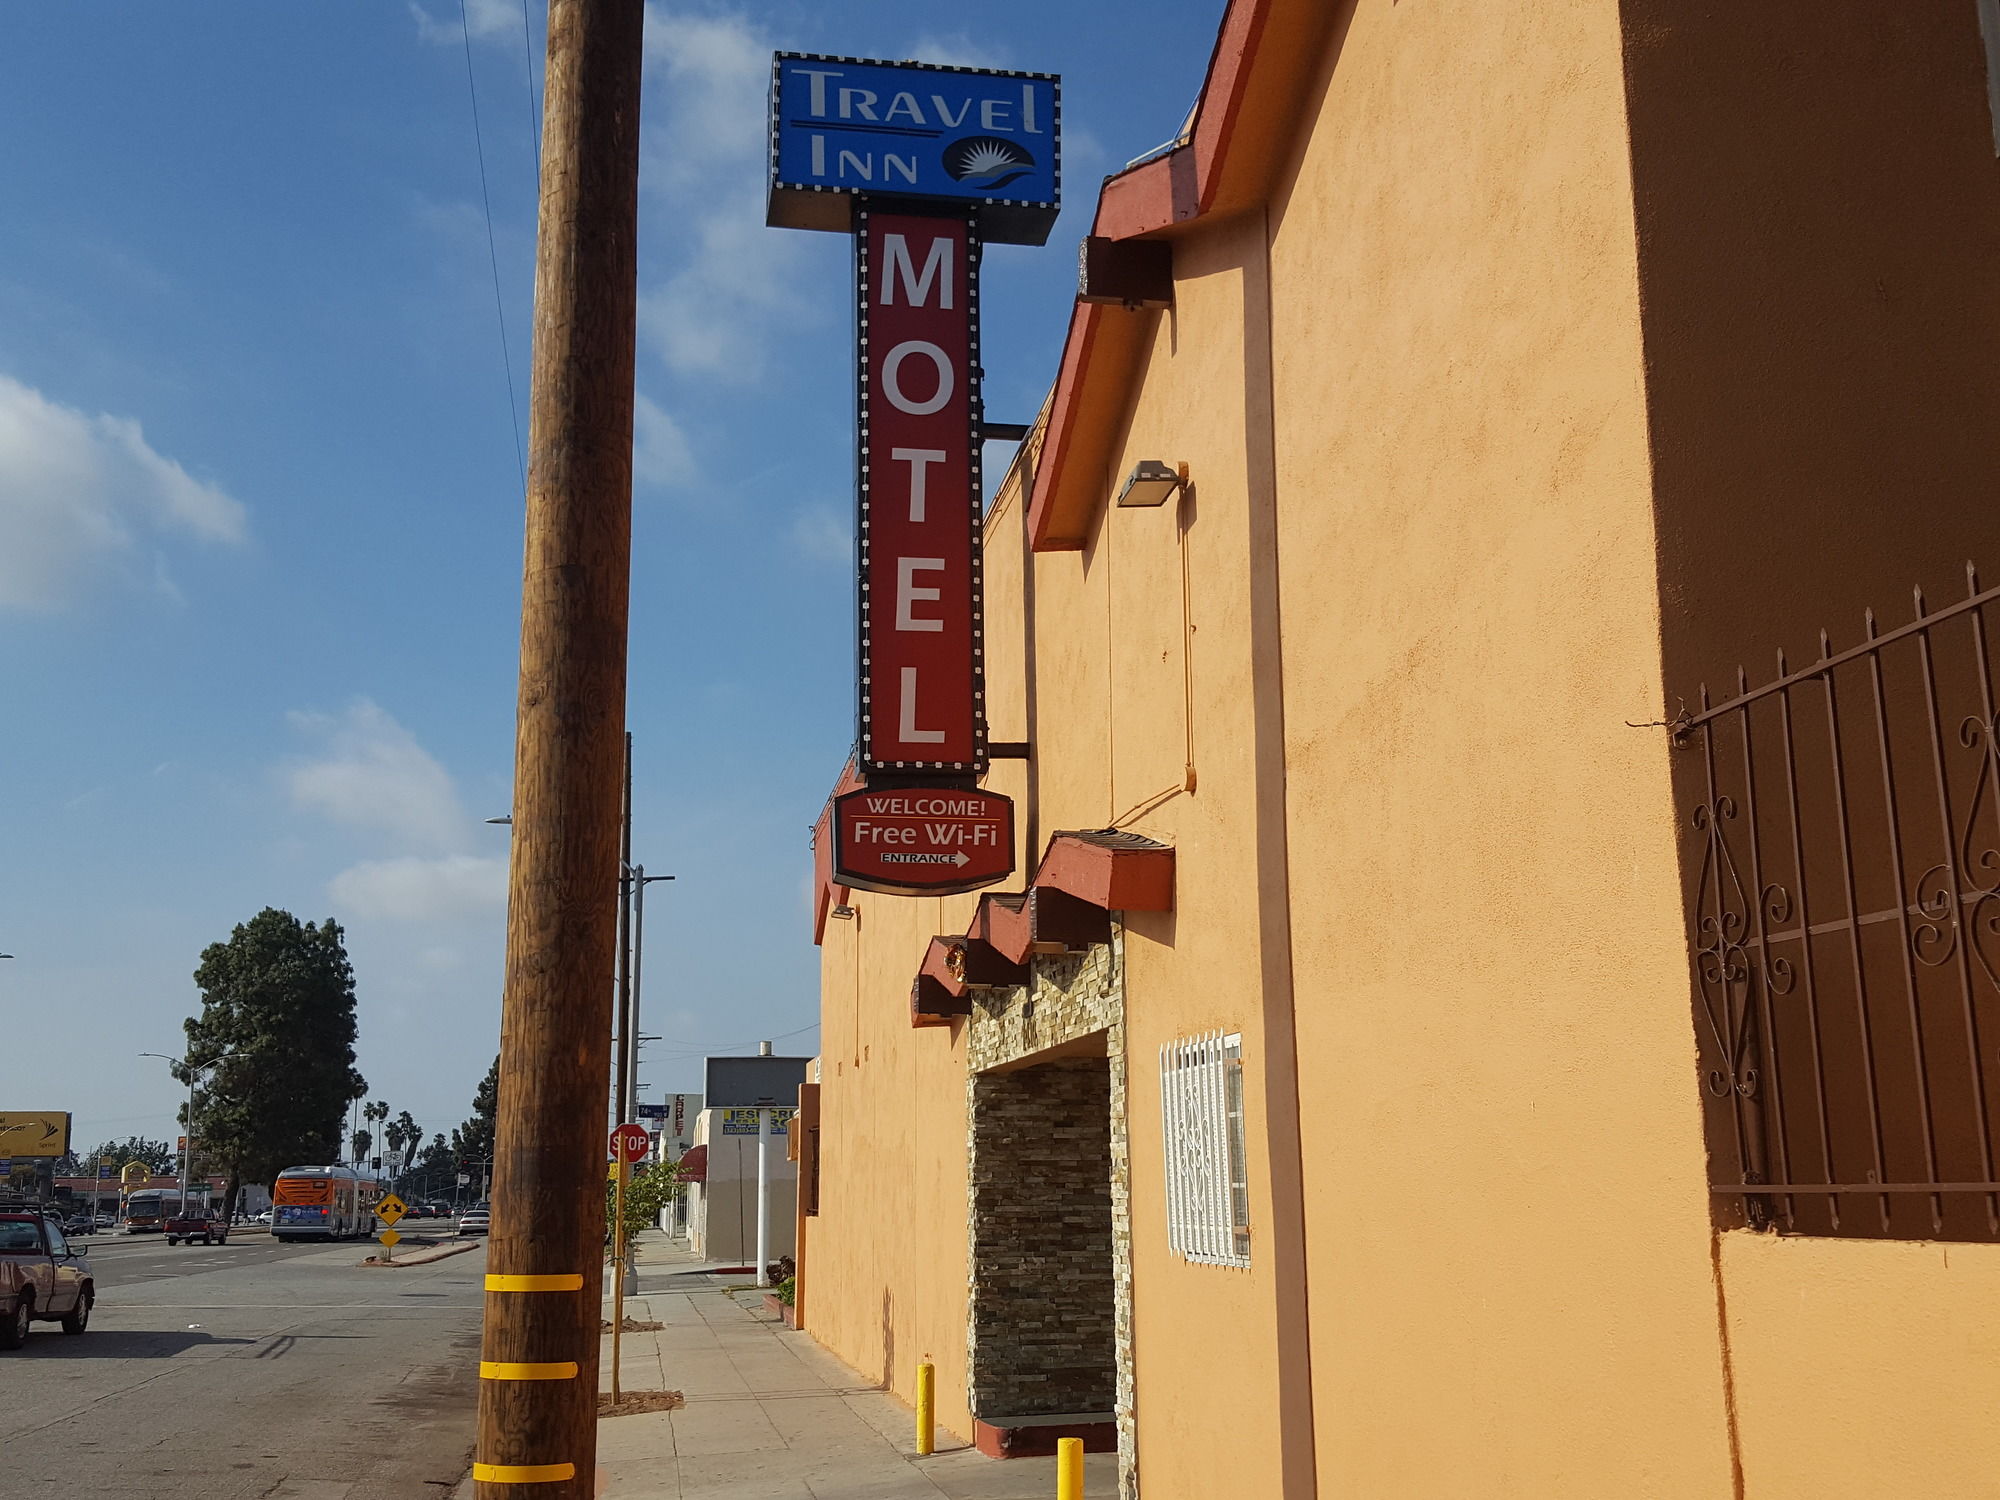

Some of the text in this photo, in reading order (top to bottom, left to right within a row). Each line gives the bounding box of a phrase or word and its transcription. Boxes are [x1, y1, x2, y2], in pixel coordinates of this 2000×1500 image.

[791, 69, 1043, 134] TRAVEL
[811, 135, 917, 184] INN
[880, 233, 954, 743] MOTEL
[866, 798, 986, 816] WELCOME!
[854, 822, 997, 846] Free Wi-Fi
[881, 853, 957, 864] ENTRANCE
[612, 1136, 646, 1151] SOP
